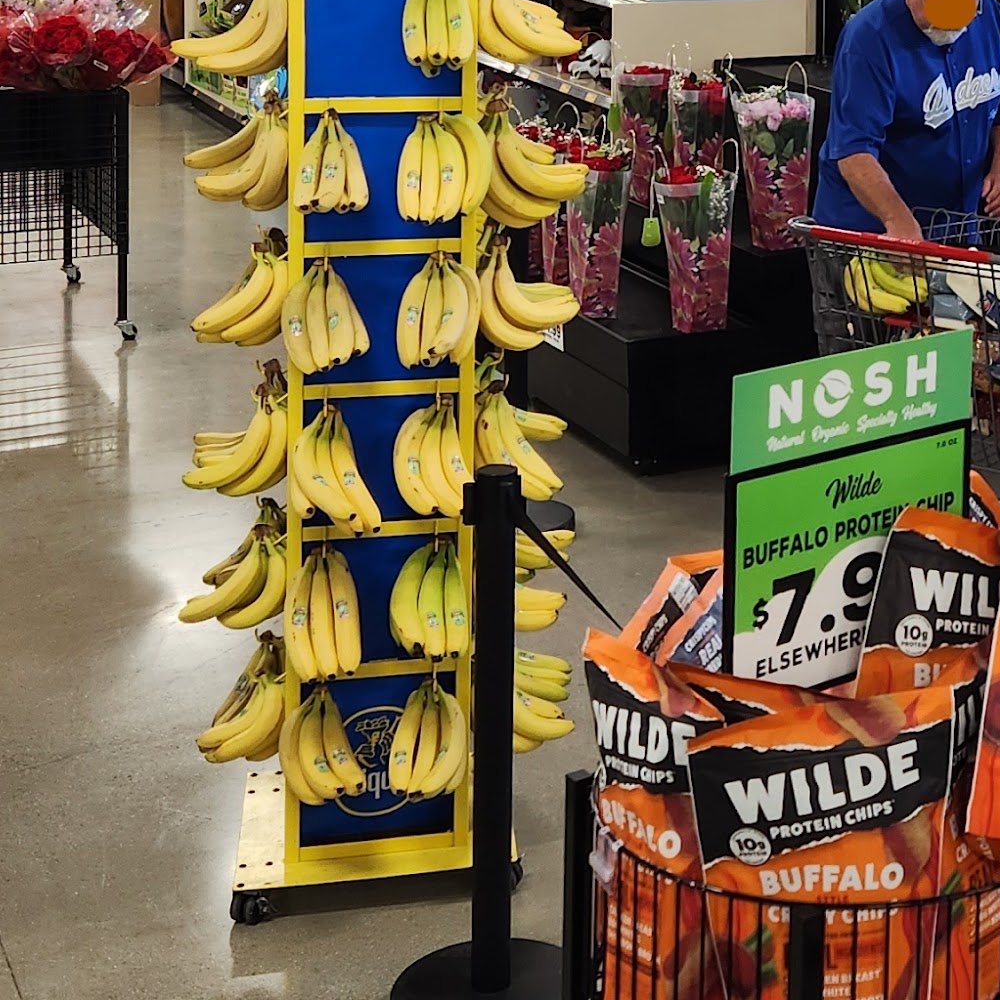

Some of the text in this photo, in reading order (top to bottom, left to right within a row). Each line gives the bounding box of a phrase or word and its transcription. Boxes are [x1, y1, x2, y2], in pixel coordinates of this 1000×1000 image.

[768, 351, 938, 429] NOSH
[766, 401, 938, 452] Natural Organic Specialty Healthy
[825, 471, 883, 509] Wilde
[742, 526, 829, 569] BUFFALO
[915, 491, 955, 514] CHIP
[902, 625, 929, 643] 10g
[935, 618, 990, 636] PROTEIN
[592, 700, 697, 767] WILDE
[639, 765, 675, 784] CHIPS
[723, 739, 920, 825] WILDE
[601, 797, 682, 859] BUFFALO
[769, 799, 894, 840] PROTEIN CHIPS
[758, 862, 905, 896] BUFFALO
[767, 904, 835, 926] CRY
